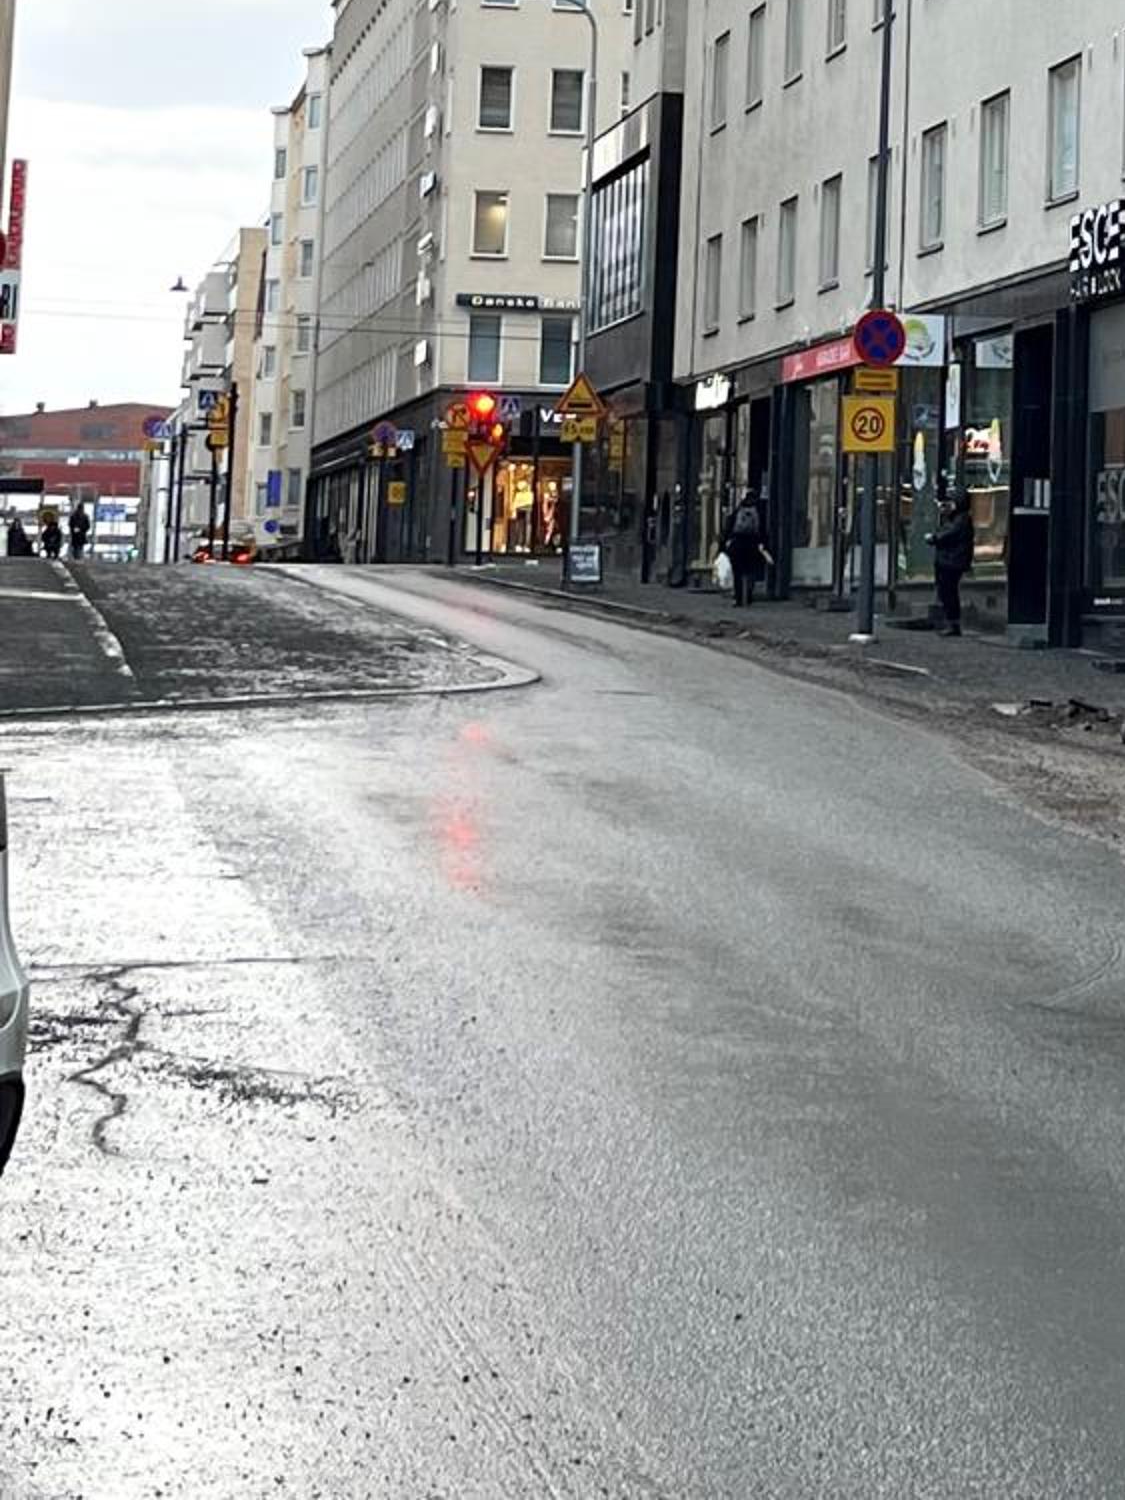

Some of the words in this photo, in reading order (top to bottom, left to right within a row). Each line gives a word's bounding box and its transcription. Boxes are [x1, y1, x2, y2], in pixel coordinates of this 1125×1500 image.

[1069, 200, 1119, 272] ESCE
[471, 295, 535, 308] Danske
[857, 415, 881, 434] 20
